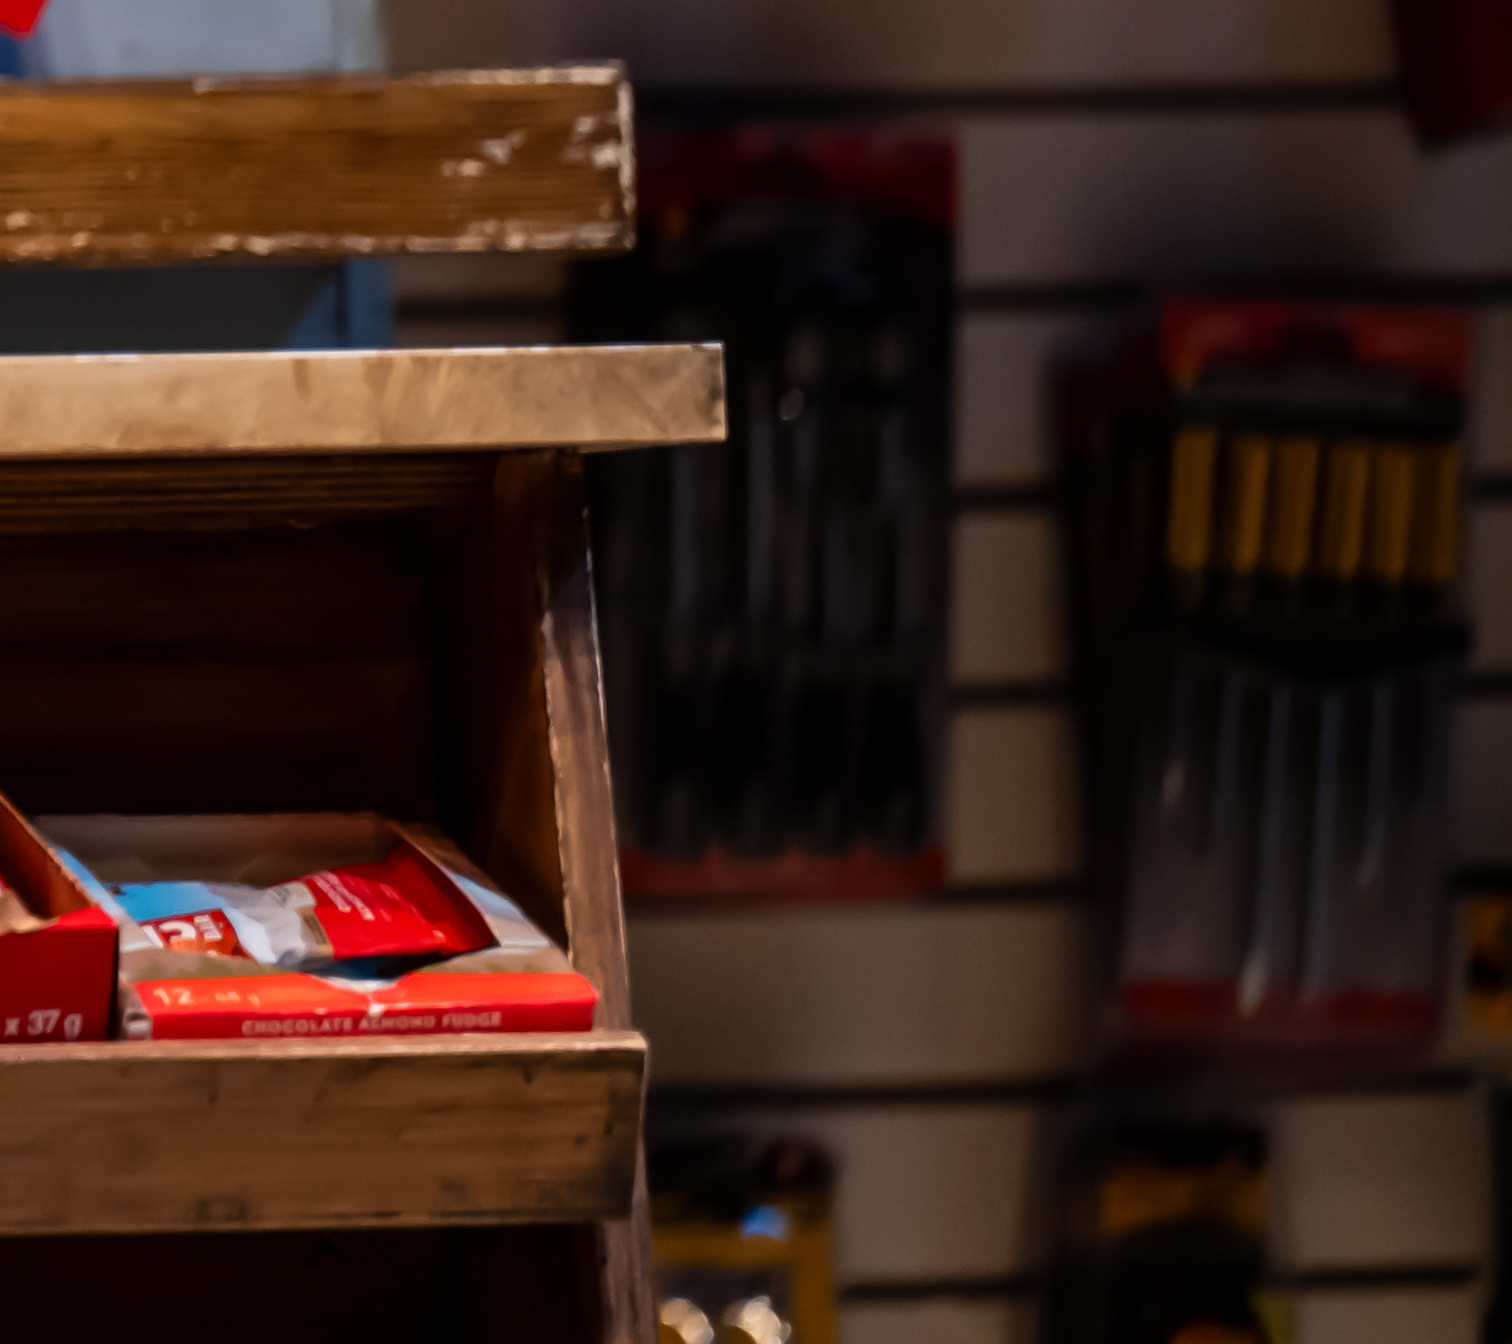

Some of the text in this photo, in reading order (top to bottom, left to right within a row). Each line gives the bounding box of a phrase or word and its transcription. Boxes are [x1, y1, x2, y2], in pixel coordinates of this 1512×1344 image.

[152, 987, 195, 1007] 12
[4, 1017, 20, 1038] x
[26, 1009, 62, 1036] 37
[64, 1012, 83, 1040] g
[241, 1016, 353, 1037] CHOCOLATE
[440, 1010, 503, 1029] FUDGE
